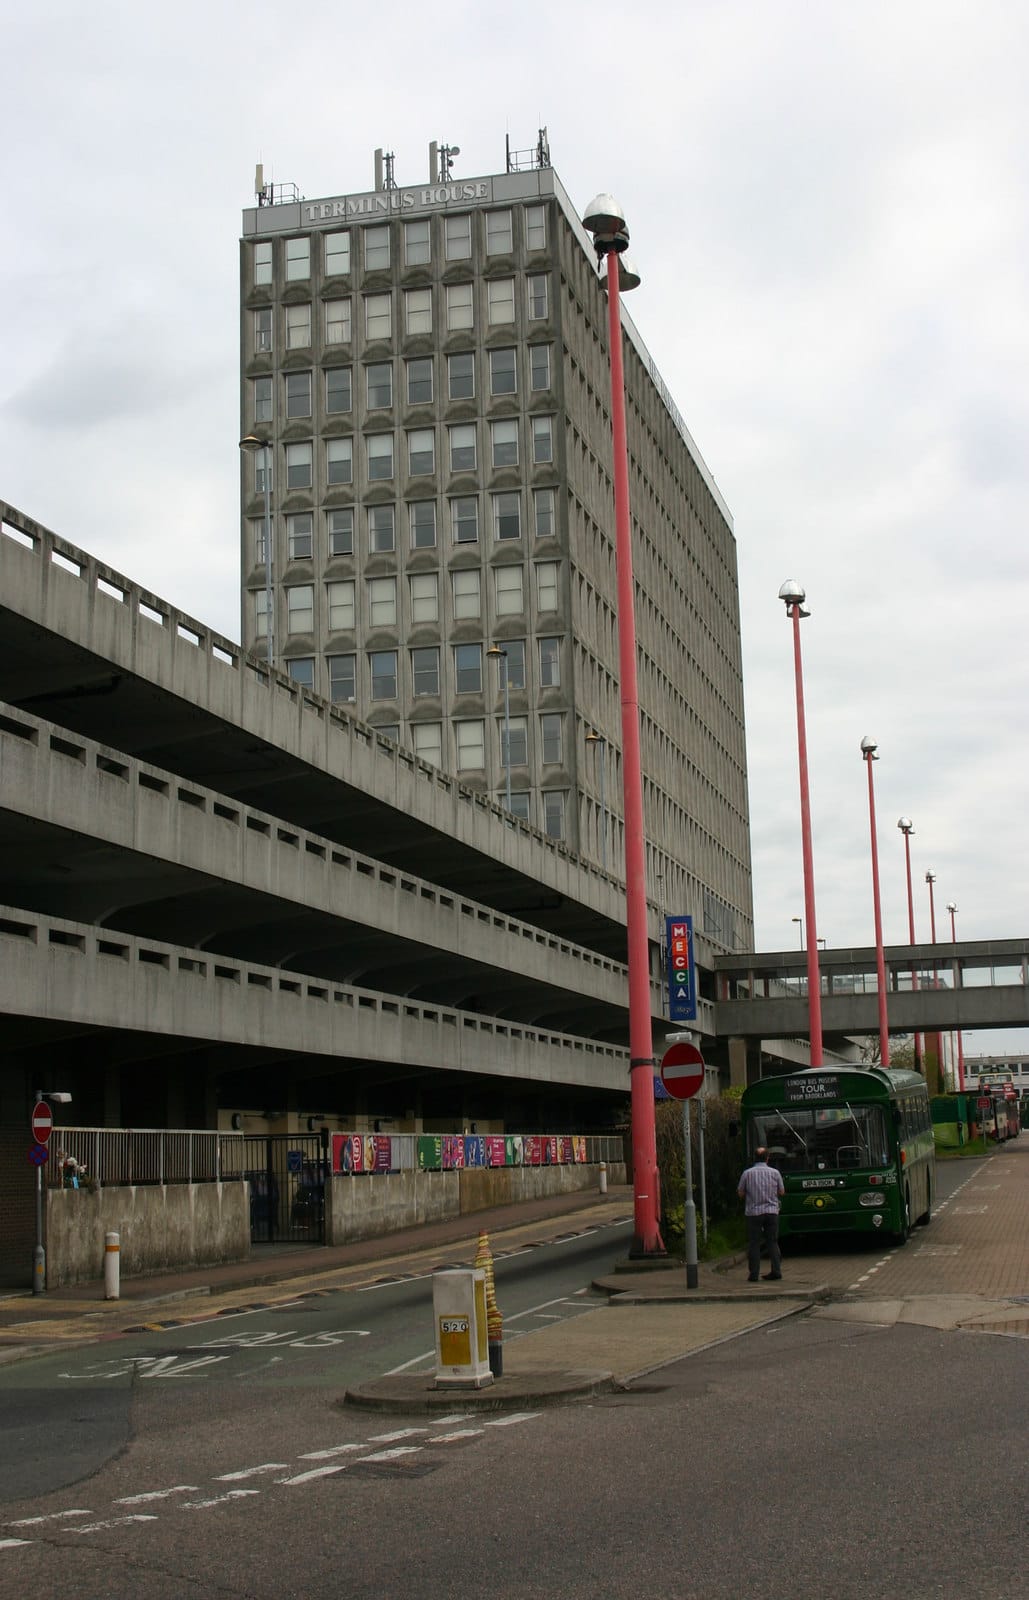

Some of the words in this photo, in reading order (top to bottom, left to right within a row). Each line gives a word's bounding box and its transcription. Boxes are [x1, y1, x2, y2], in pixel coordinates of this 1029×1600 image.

[305, 192, 416, 221] TERMINUS
[420, 182, 489, 205] HOUSE
[673, 926, 687, 999] MECCA
[800, 1084, 826, 1094] TOUR
[442, 1322, 467, 1332] 520
[186, 1330, 371, 1349] BUS
